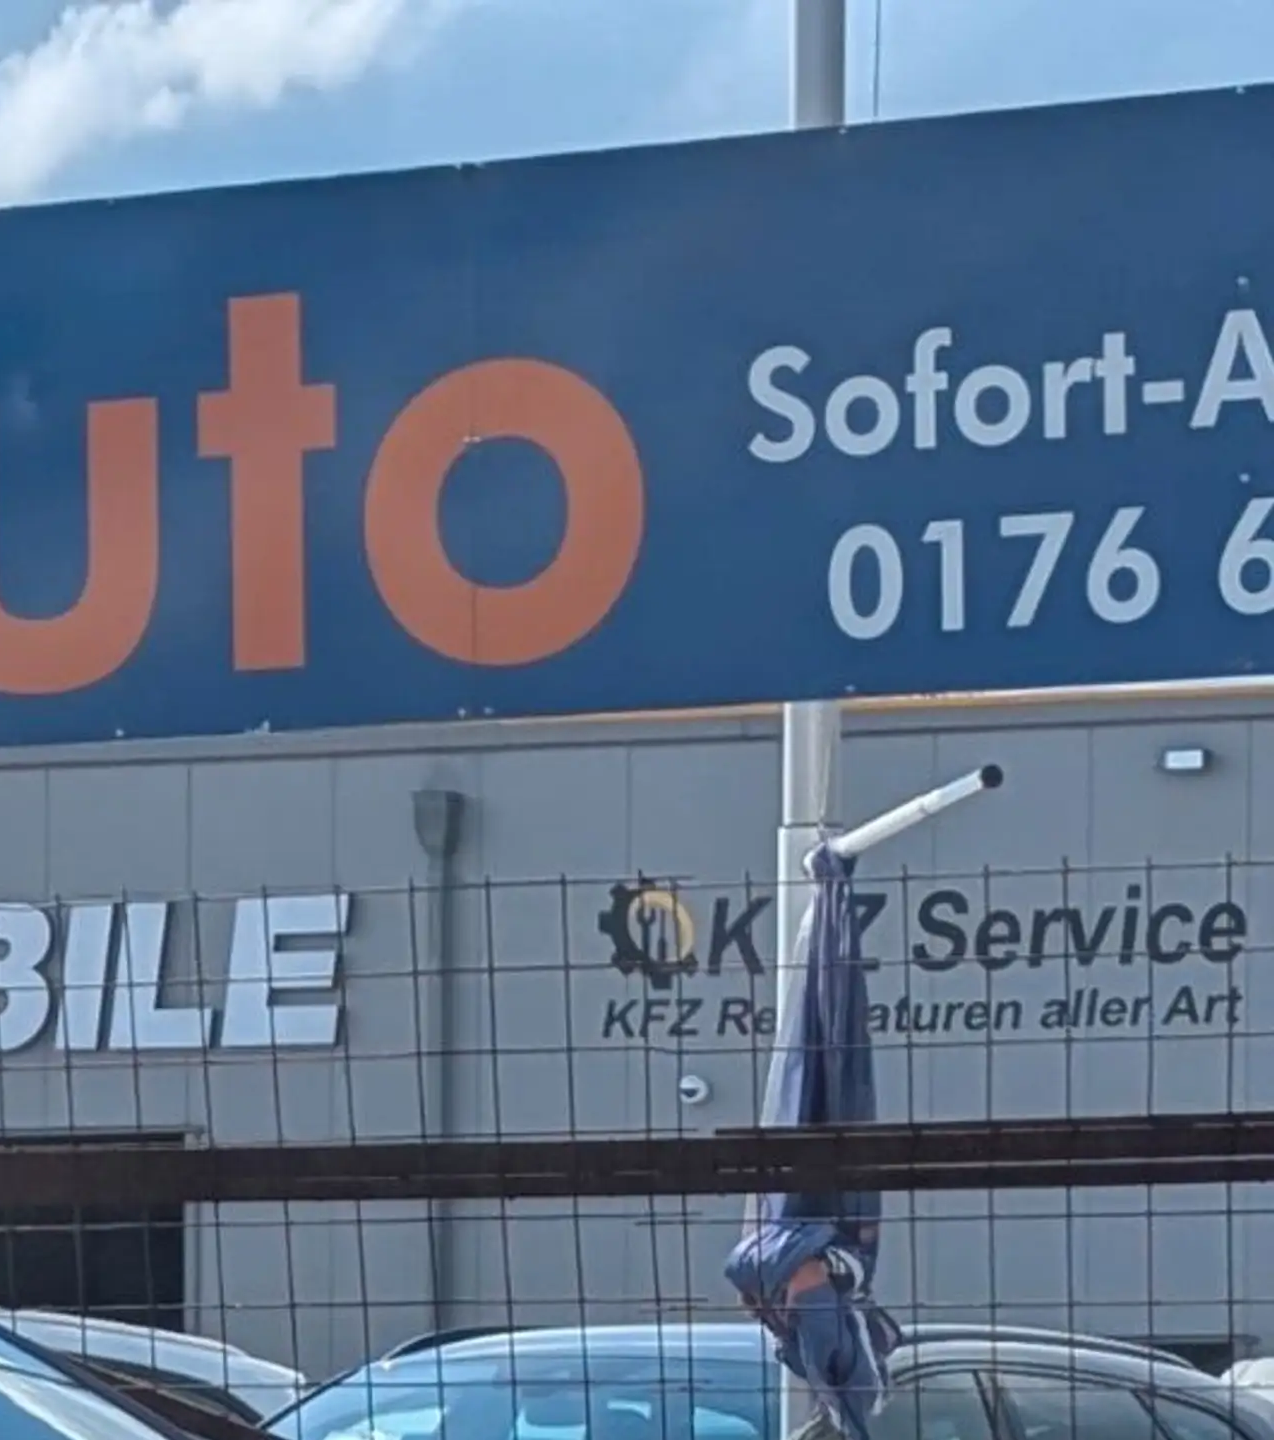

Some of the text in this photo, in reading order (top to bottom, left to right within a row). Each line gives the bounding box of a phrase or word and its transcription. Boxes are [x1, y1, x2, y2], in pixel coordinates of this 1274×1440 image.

[748, 309, 1274, 463] Sofort-A
[827, 506, 1160, 641] 0176
[707, 885, 1249, 975] KZ Service
[601, 985, 1243, 1038] KFZ Reaturen aller Art
